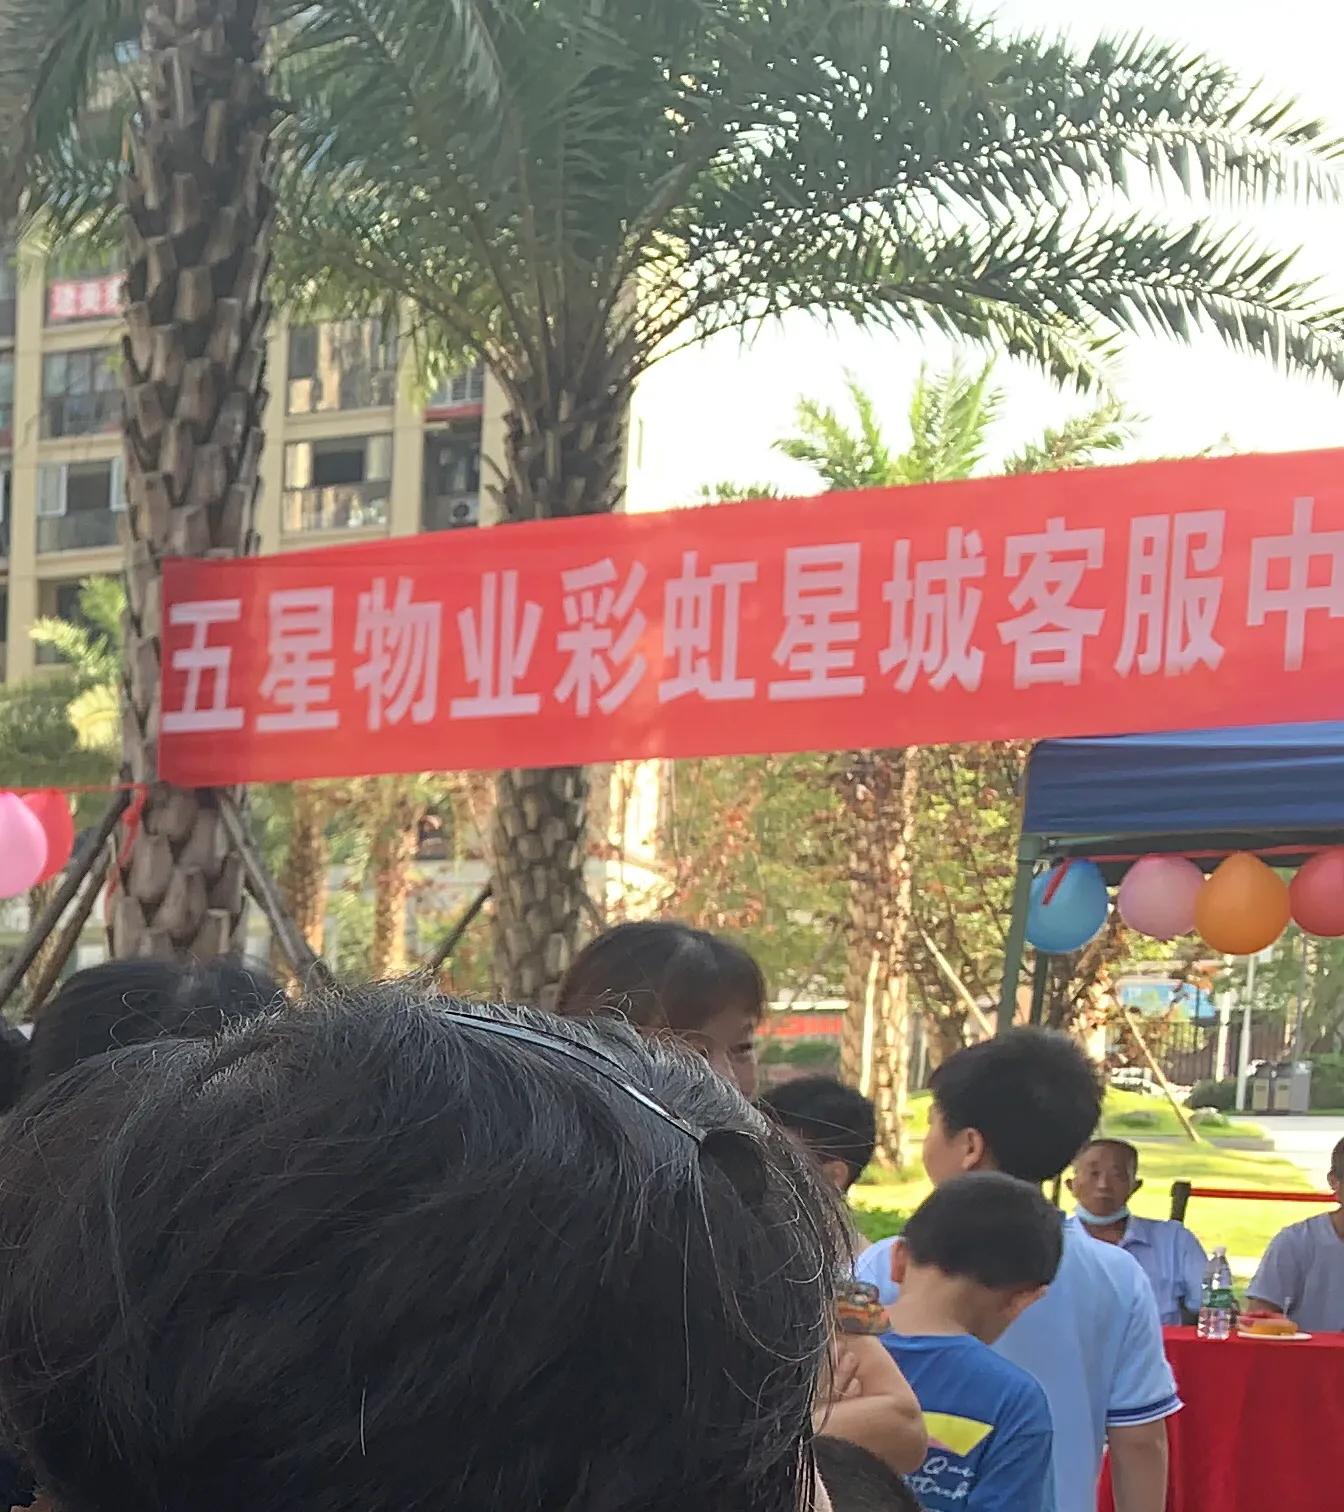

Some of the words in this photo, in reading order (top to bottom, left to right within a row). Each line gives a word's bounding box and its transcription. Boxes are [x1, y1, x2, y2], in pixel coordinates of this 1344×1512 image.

[161, 496, 1344, 735] 五星物业彩虹星城客服中
